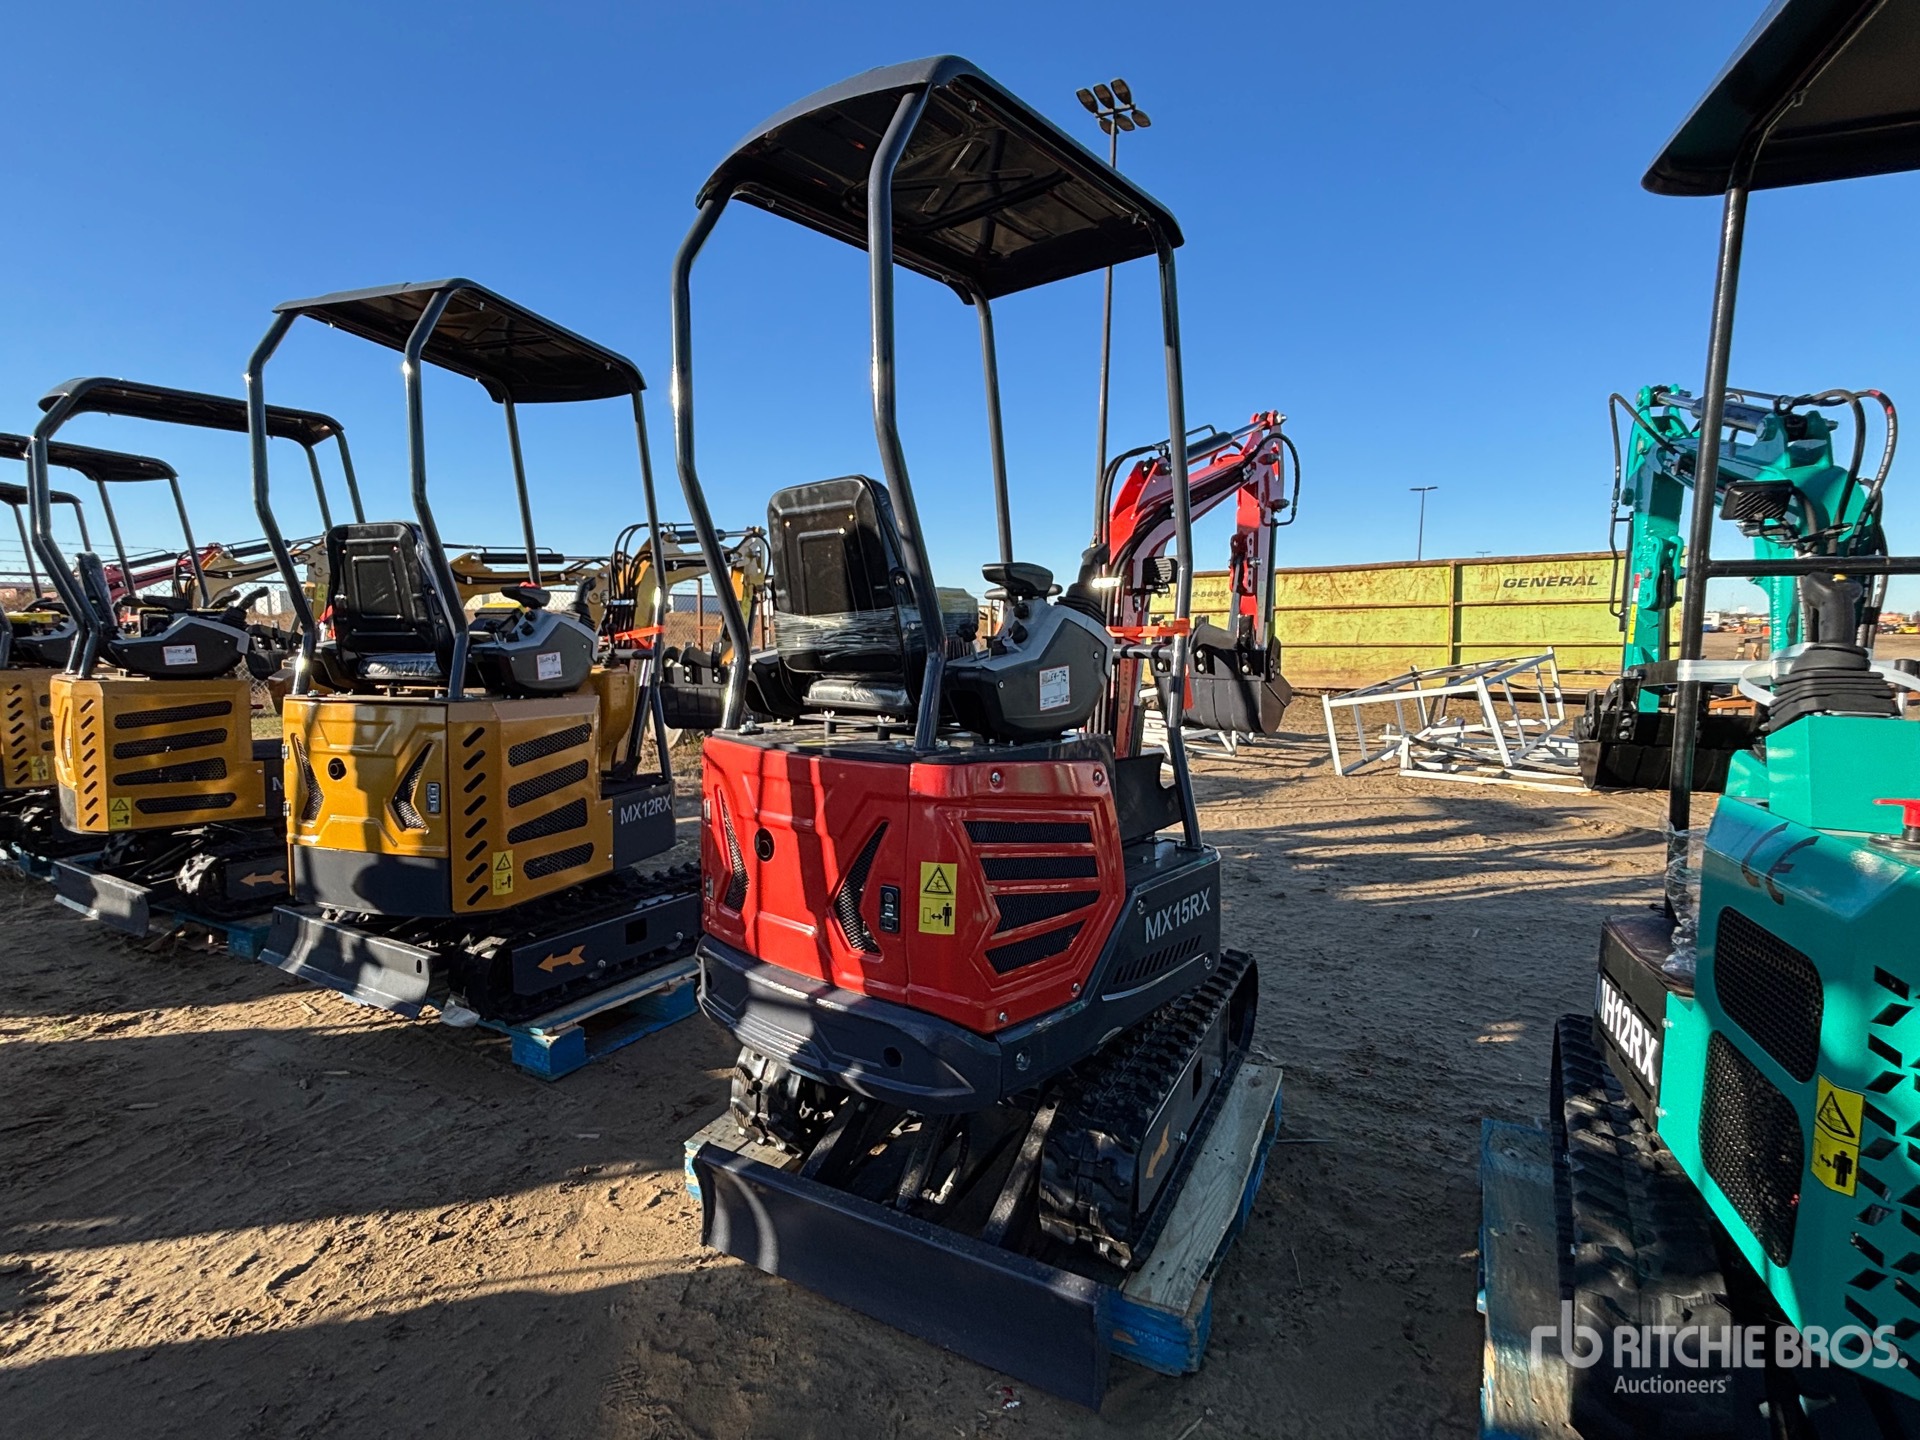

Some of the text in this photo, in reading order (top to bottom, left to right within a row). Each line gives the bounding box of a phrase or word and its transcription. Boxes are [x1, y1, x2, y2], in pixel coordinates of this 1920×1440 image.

[1503, 575, 1598, 588] GENERAL
[620, 794, 671, 825] MX12RX
[1145, 887, 1211, 944] MX15RX
